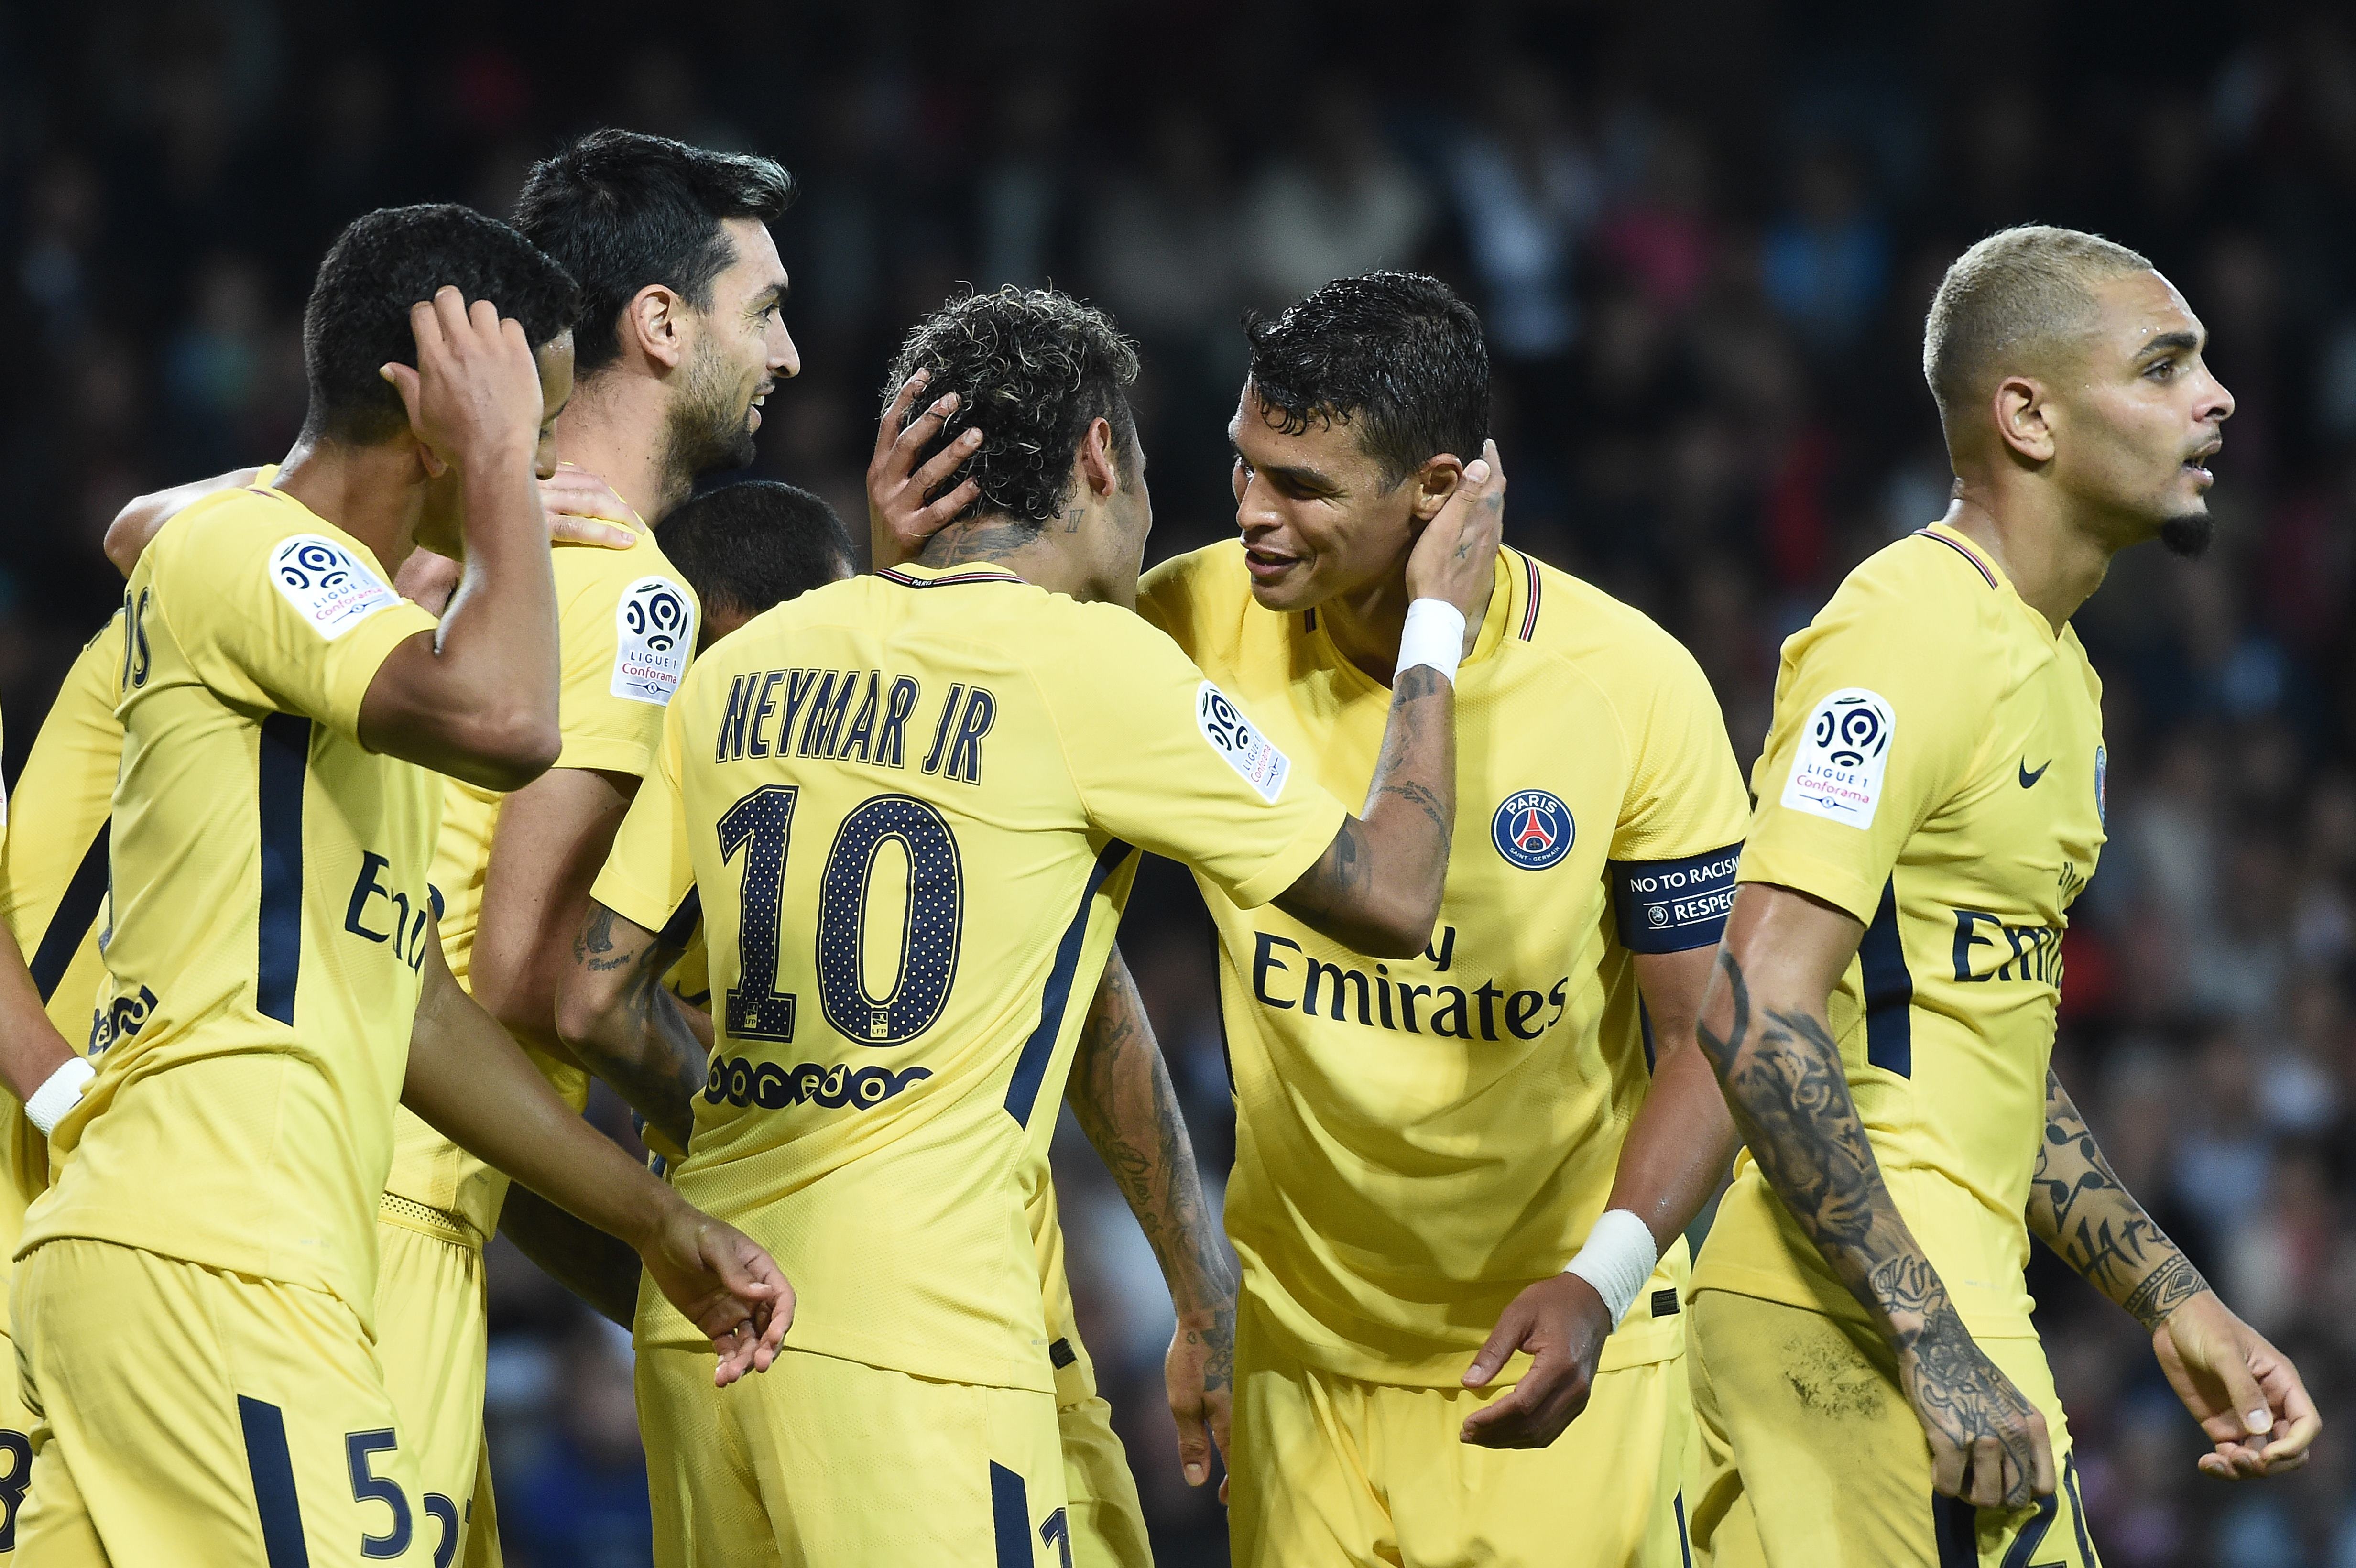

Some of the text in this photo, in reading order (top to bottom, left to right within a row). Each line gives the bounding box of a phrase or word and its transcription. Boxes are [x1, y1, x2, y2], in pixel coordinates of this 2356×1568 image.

[313, 584, 357, 608] LIGUE
[316, 588, 383, 620] Conforama
[622, 663, 677, 684] Conforama
[630, 651, 677, 669] LIGUE 1
[716, 668, 997, 785] NEYMAR JR
[1243, 741, 1260, 771] LIGUE
[1251, 744, 1271, 783] Conforama
[1797, 774, 1870, 804] Conforama
[1807, 764, 1868, 787] LIGUE 1
[1506, 795, 1558, 815] PARIS
[1630, 877, 1658, 893] NO
[1659, 872, 1686, 890] TO
[716, 784, 965, 1047] 10
[1252, 930, 1569, 1041] Emirates
[345, 1427, 413, 1560] 5
